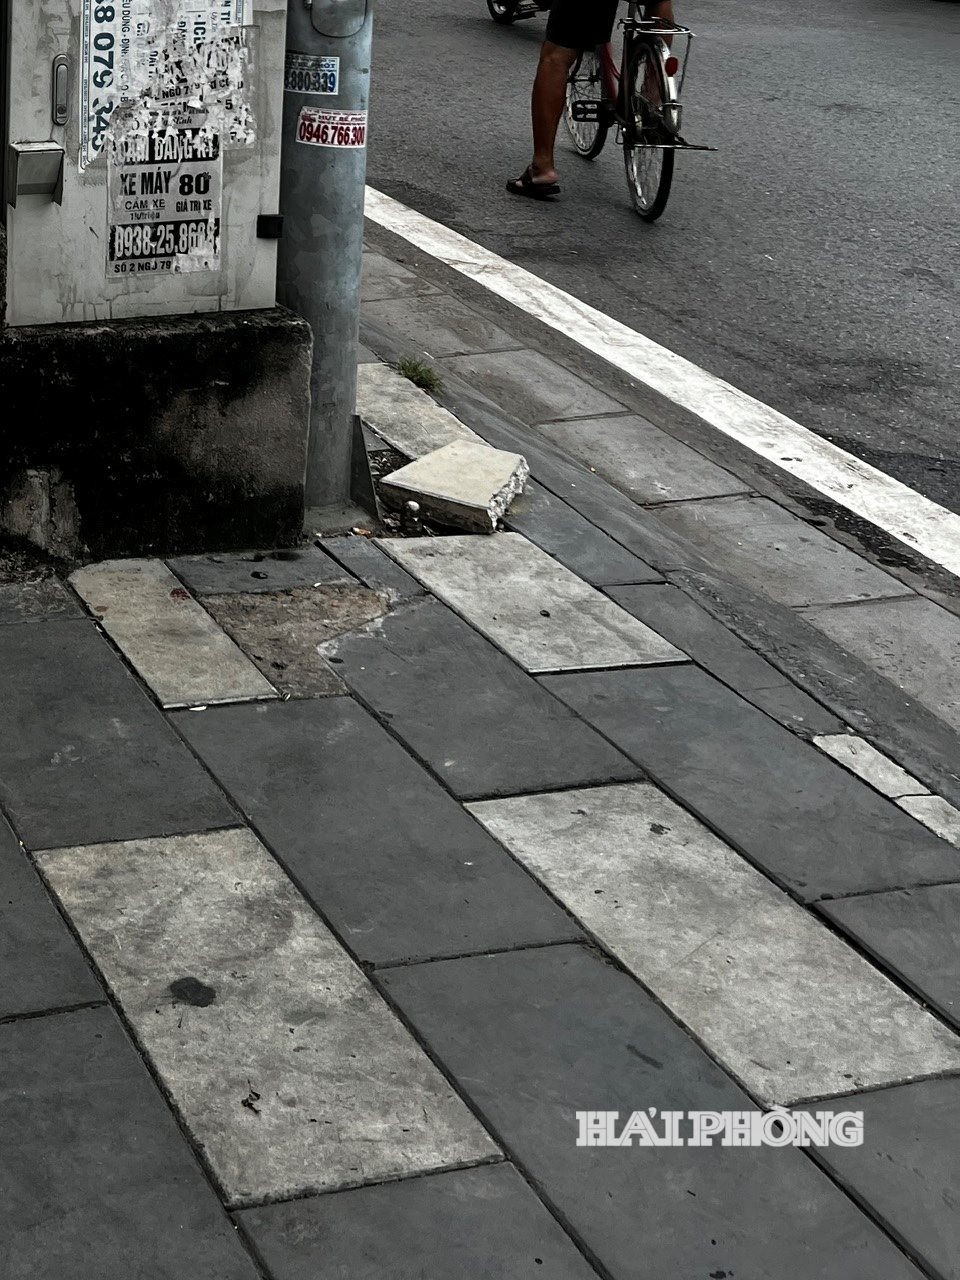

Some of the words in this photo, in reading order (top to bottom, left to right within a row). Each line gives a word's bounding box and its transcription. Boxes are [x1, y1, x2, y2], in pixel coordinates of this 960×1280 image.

[120, 172, 137, 197] XE
[140, 166, 172, 195] MÁY
[152, 198, 166, 209] XE
[203, 199, 212, 211] XE
[114, 260, 127, 273] SỐ
[129, 262, 136, 272] 2
[160, 260, 172, 270] 79
